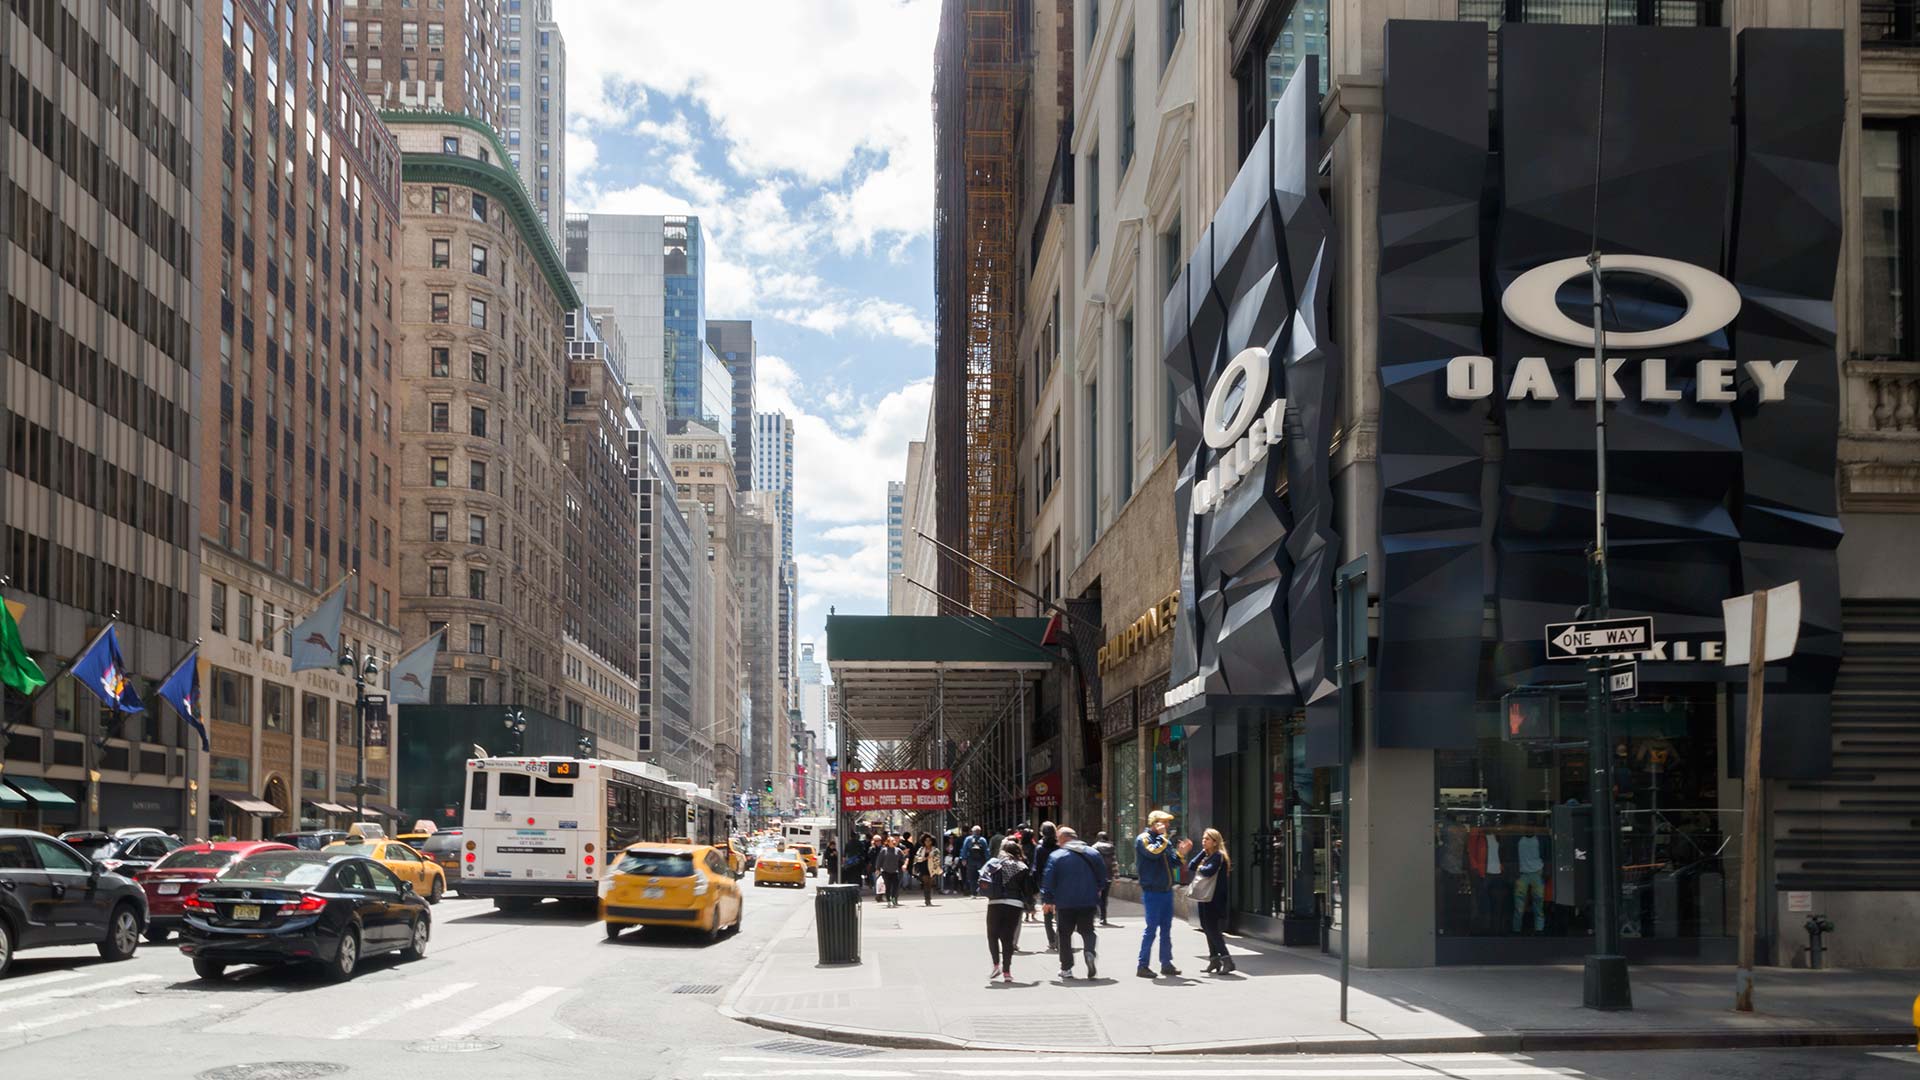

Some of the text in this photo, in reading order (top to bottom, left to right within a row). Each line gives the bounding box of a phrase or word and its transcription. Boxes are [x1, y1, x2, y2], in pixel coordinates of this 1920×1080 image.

[1447, 356, 1798, 402] OAKLEY
[1098, 590, 1180, 678] PHILIPPINES
[1563, 629, 1638, 647] ONE WAY
[232, 647, 251, 668] THE
[307, 672, 340, 694] FRENCH
[1615, 675, 1630, 689] WAY
[525, 765, 548, 773] 6673
[863, 777, 930, 791] SMILER'S
